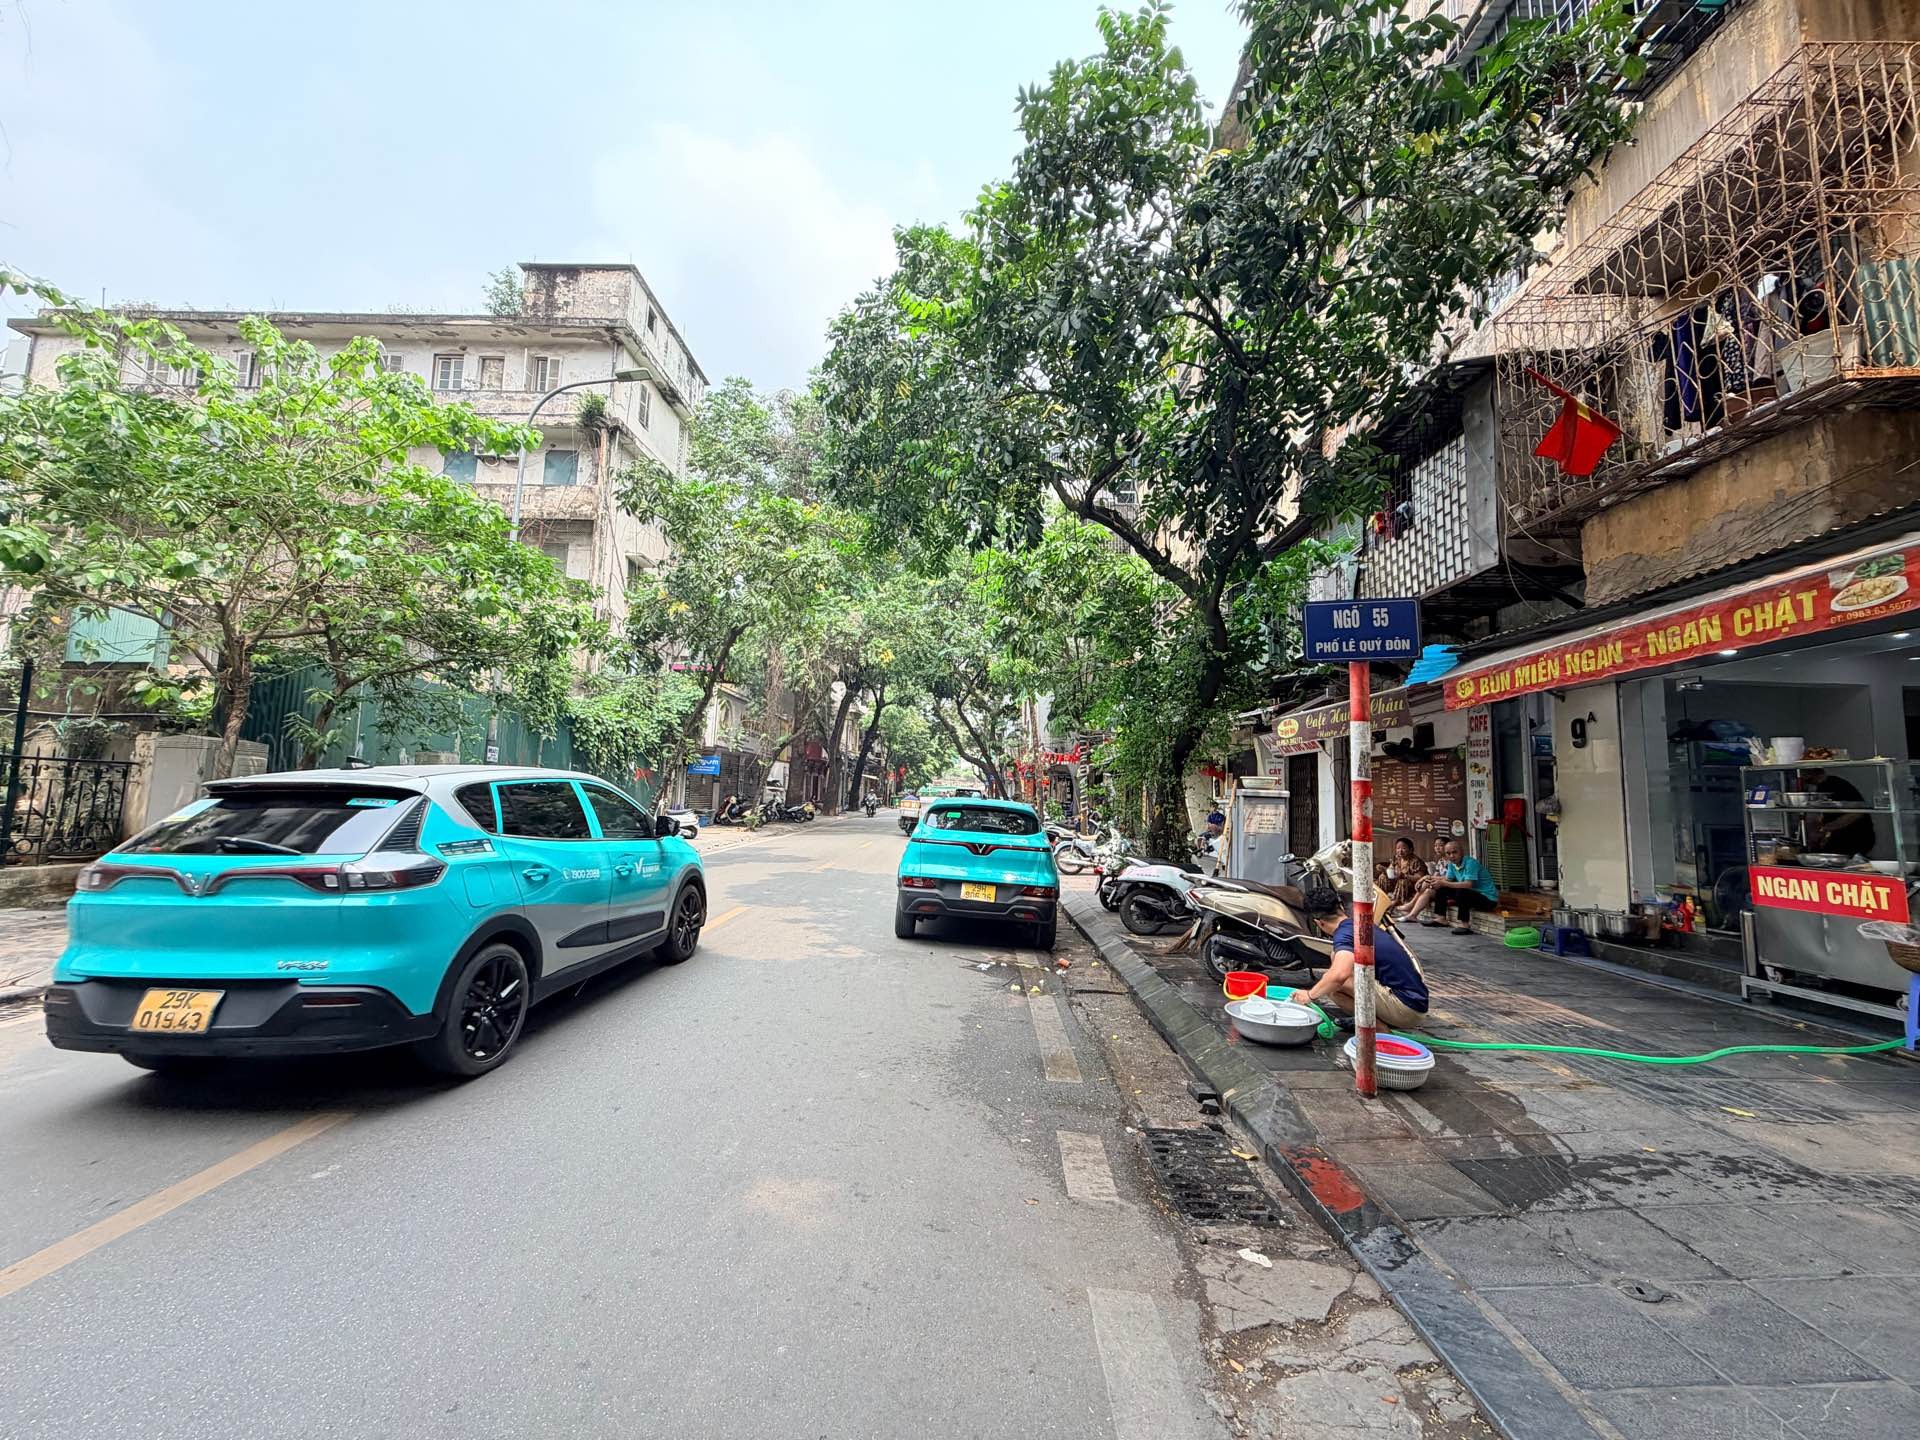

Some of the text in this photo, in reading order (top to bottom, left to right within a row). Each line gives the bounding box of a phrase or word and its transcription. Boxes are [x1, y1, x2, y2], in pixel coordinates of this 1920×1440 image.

[1333, 605, 1389, 629] NGÕ 55
[1315, 636, 1411, 653] PHỐ LÊ QUÝ ĐÔN
[1479, 671, 1511, 696] BÚN
[1515, 653, 1560, 688] MIẾN
[1565, 640, 1623, 677] NGAN
[1646, 614, 1722, 657] NGAN
[1733, 589, 1818, 634] CHẶT
[1305, 712, 1327, 730] Café
[1470, 714, 1488, 733] CAFE
[1470, 779, 1485, 788] SINH
[1757, 875, 1891, 914] NGAN CHẶT
[159, 991, 200, 1009] 29K
[139, 1010, 202, 1030] 019.43
